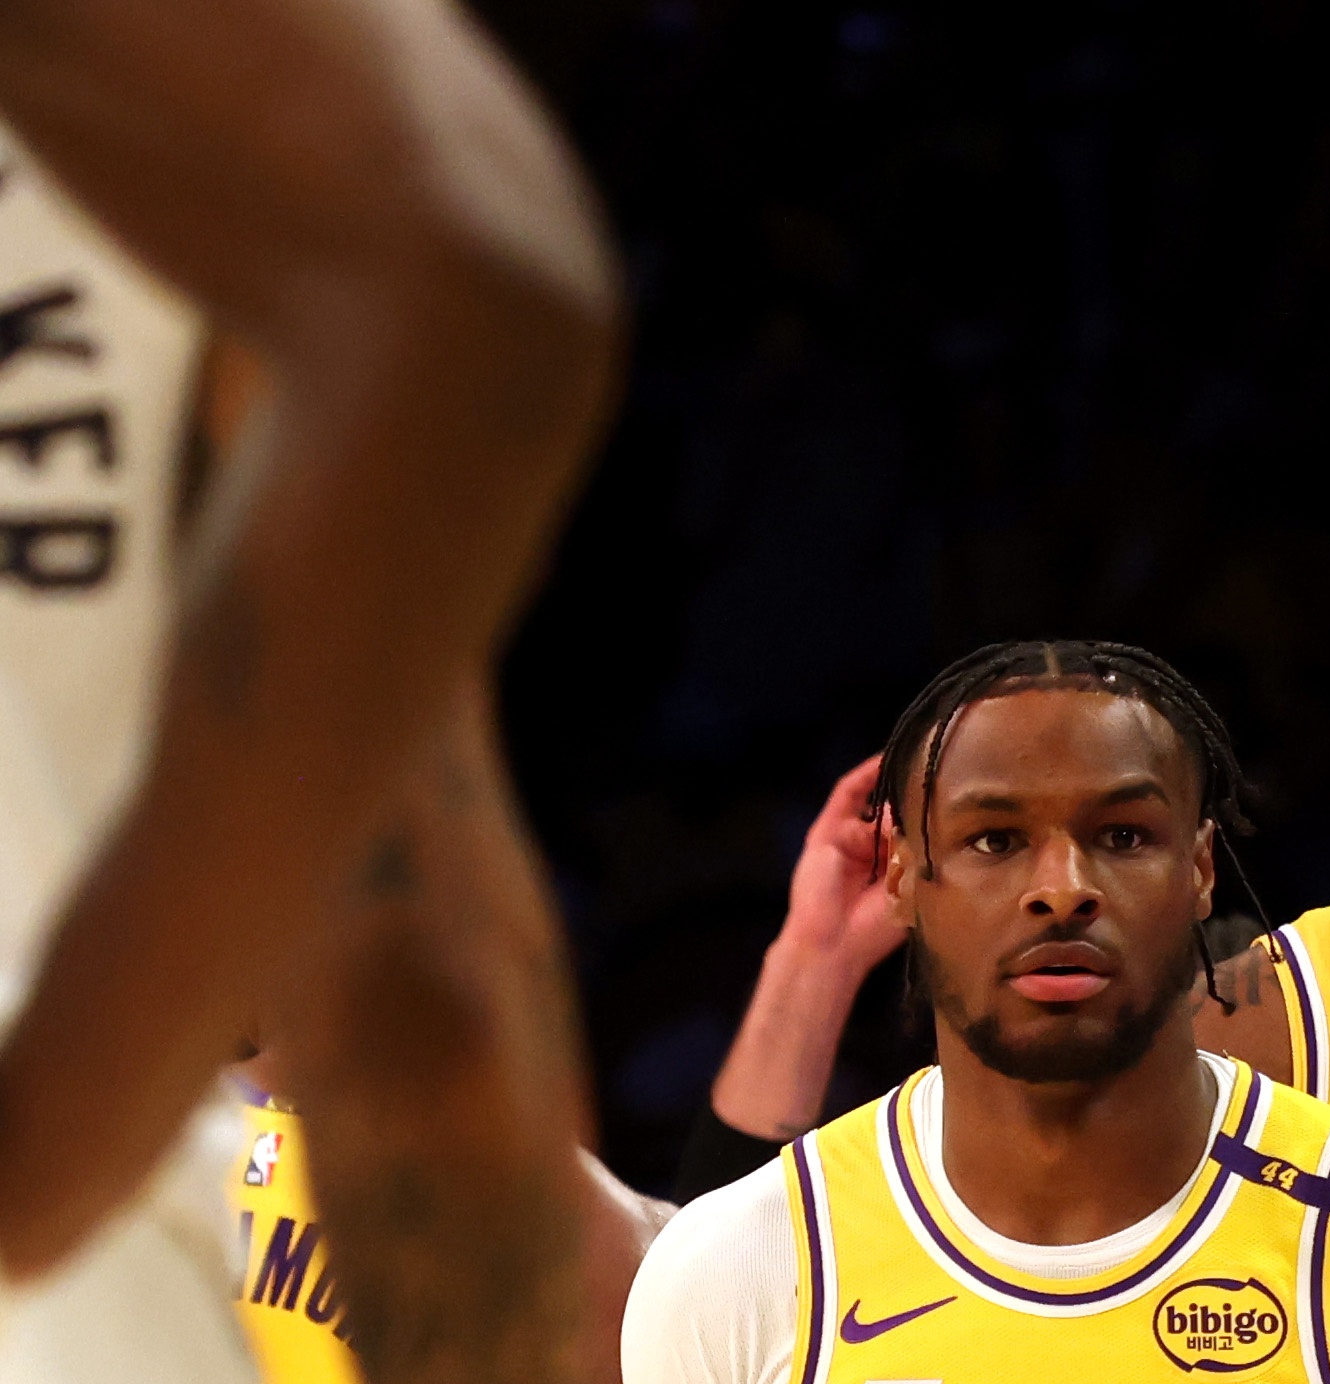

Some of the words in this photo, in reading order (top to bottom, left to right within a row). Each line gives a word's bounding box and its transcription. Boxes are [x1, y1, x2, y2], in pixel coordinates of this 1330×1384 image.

[1260, 1161, 1299, 1191] 44
[1166, 1302, 1279, 1344] bibigo
[1187, 1336, 1234, 1351] 비비고
